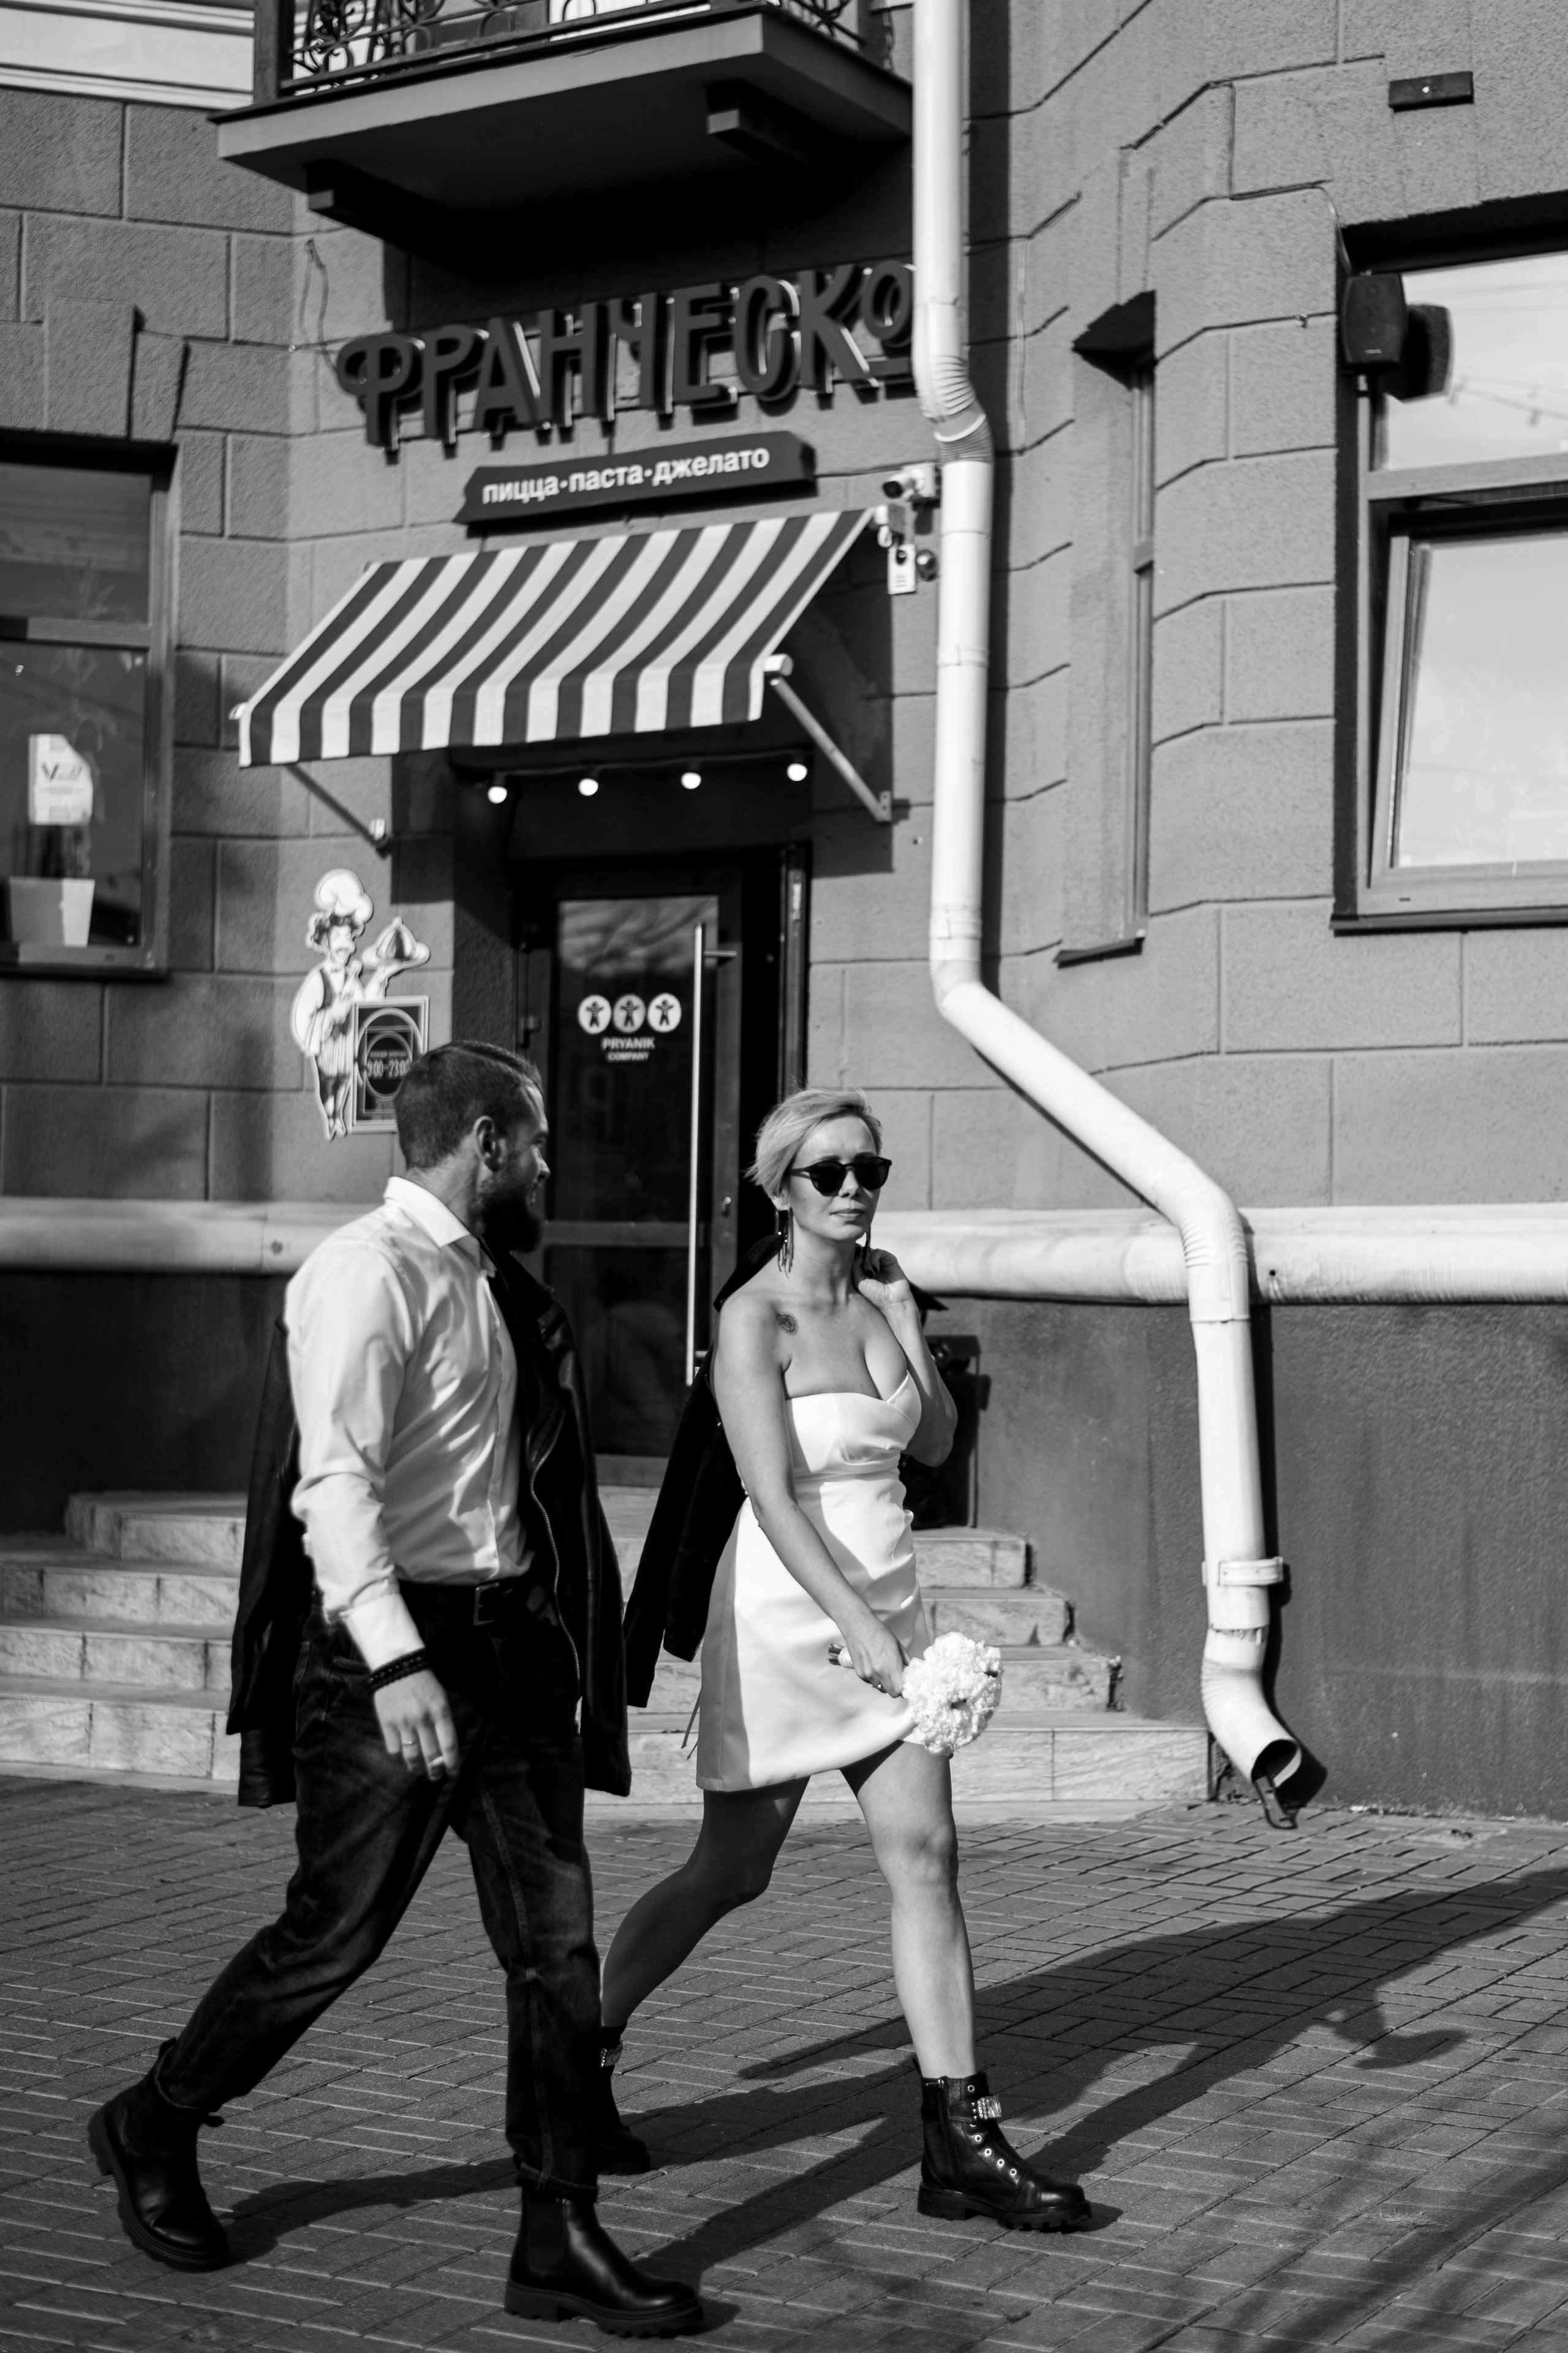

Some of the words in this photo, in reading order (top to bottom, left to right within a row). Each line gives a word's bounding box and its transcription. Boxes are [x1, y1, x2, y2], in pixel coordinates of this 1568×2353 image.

[336, 260, 916, 451] ФРАНЧЕСКО
[602, 1037, 655, 1050] PRYANIK
[607, 1052, 649, 1063] COMPANY
